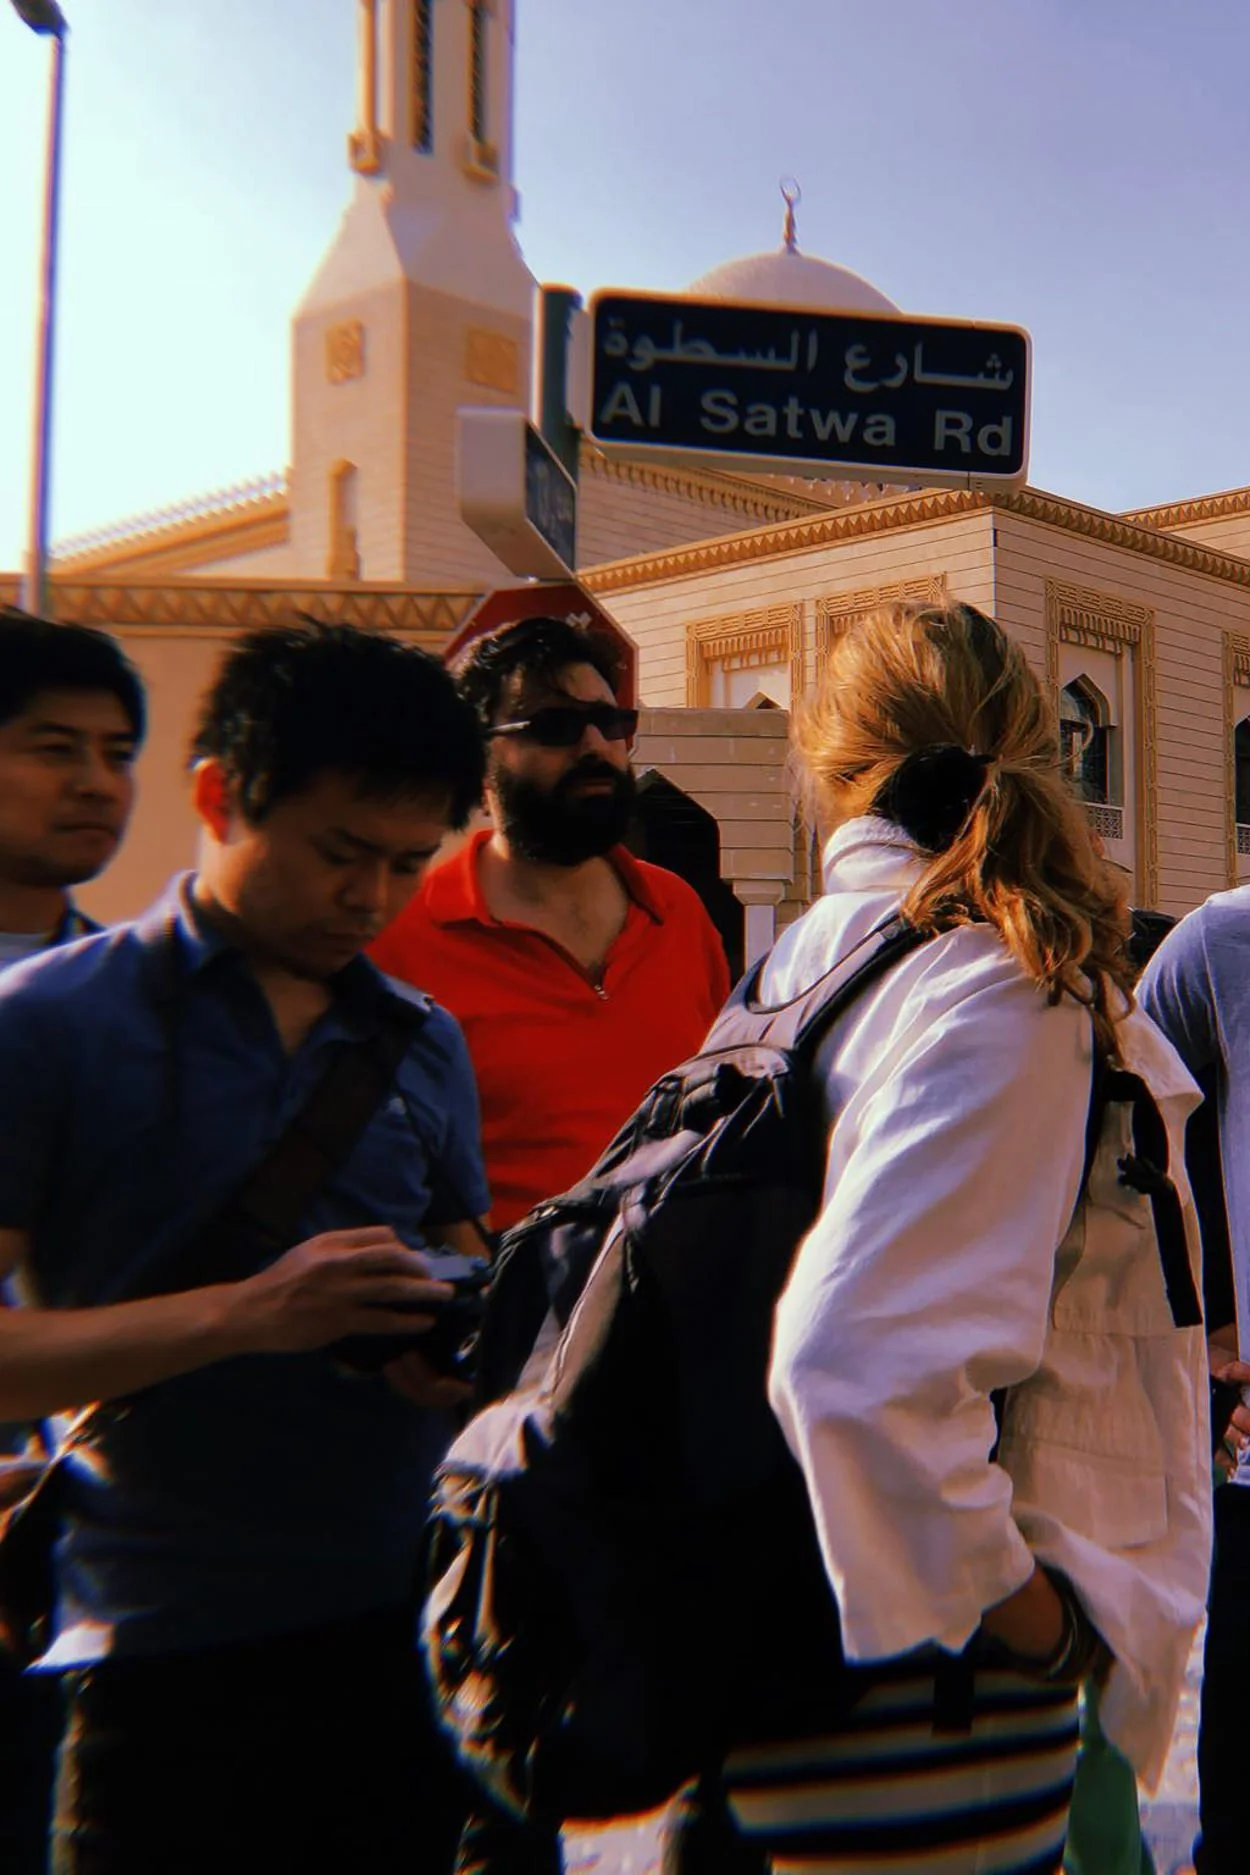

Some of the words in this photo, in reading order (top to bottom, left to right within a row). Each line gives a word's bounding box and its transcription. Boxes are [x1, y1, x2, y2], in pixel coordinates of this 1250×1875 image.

[603, 313, 818, 371] السطوة
[843, 341, 1014, 392] شارع
[601, 381, 661, 428] Al
[700, 389, 896, 448] Satwa
[933, 409, 1013, 456] Rd
